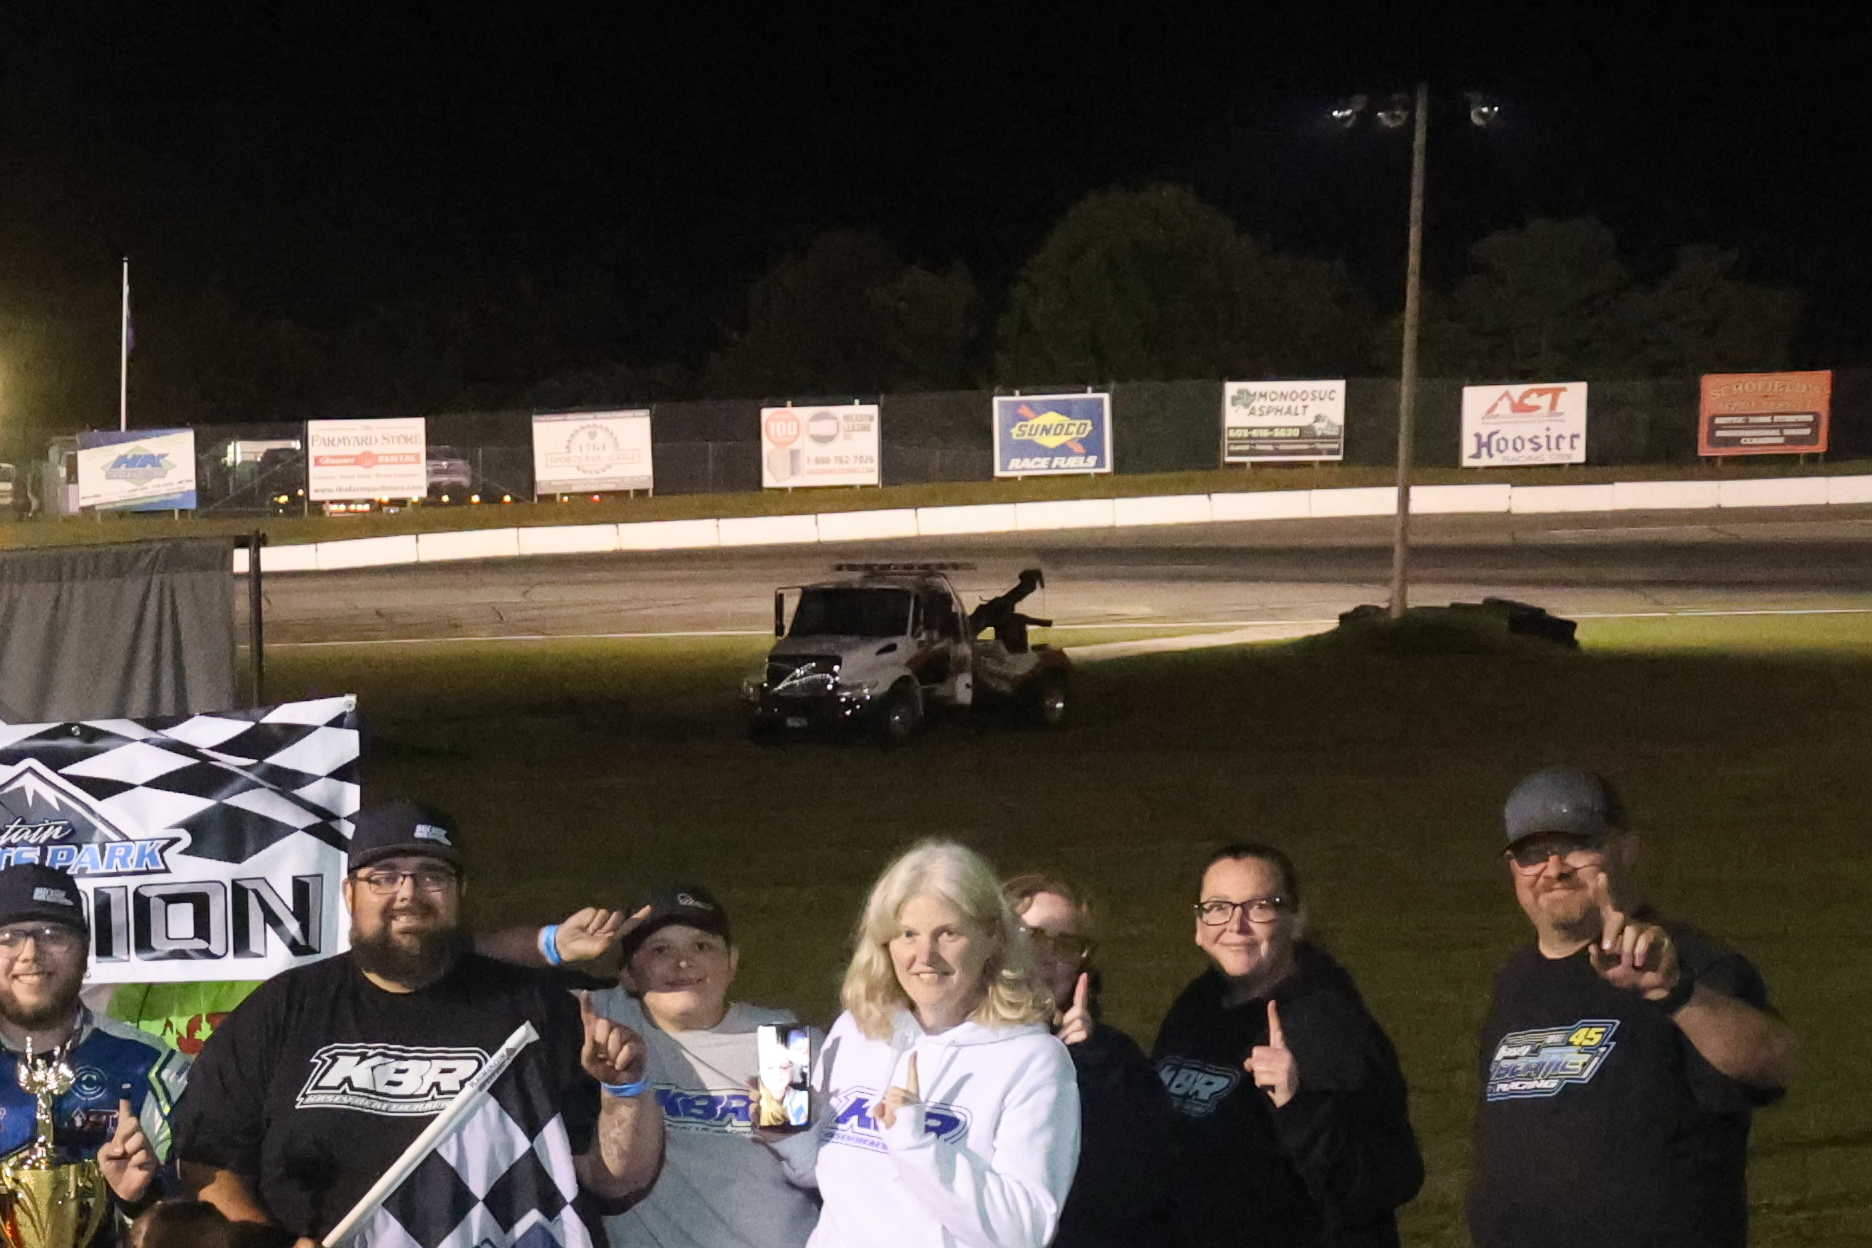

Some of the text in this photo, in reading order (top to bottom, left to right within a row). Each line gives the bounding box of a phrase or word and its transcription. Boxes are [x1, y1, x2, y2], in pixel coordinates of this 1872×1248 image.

[1484, 387, 1568, 414] ACT
[1248, 405, 1309, 416] ASPHALT
[770, 420, 798, 437] 100
[1016, 422, 1088, 438] SUNOCO
[311, 433, 422, 447] FARMYARD STORE
[1467, 426, 1581, 459] Hoosier
[1008, 455, 1098, 469] RACE FUELS
[47, 839, 171, 876] PARK
[1568, 1026, 1607, 1047] 45
[317, 1055, 480, 1096] KBR
